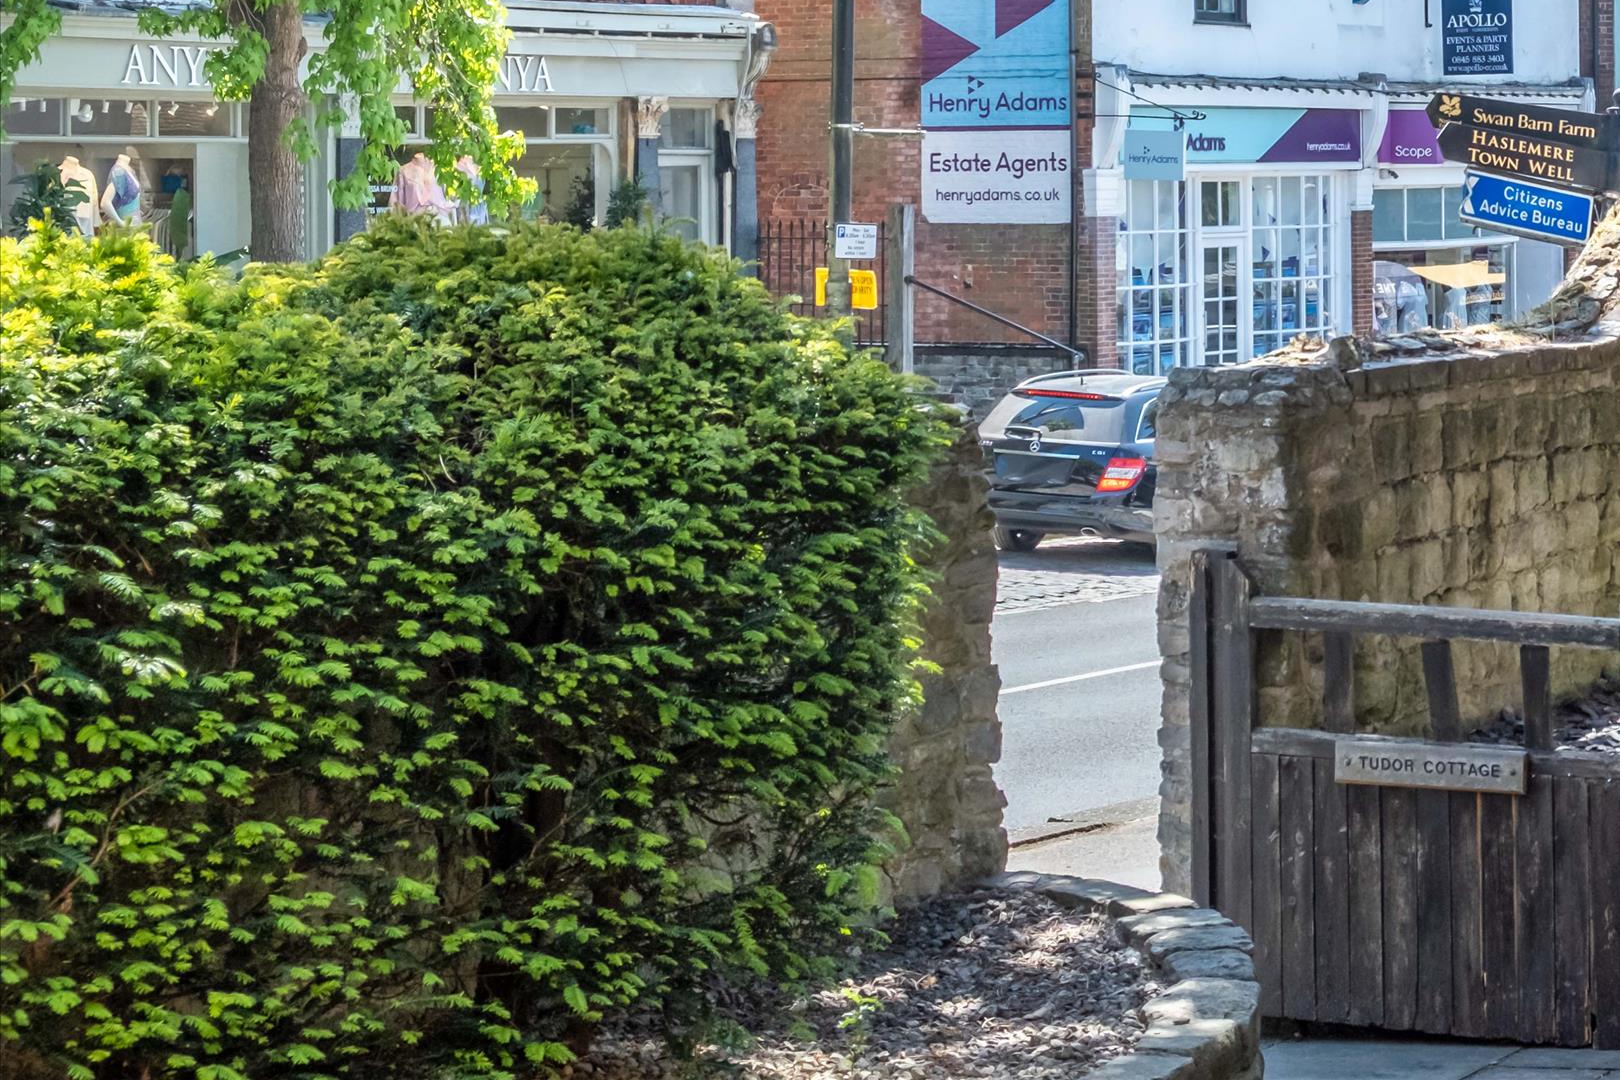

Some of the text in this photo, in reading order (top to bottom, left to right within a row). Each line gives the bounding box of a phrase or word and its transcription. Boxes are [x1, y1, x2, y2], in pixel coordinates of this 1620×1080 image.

[1446, 13, 1507, 28] APOLLO
[1446, 34, 1508, 45] EVENTS & PARTY
[1456, 44, 1500, 53] PLANNERS
[121, 44, 213, 86] ANY
[494, 55, 555, 92] NYA
[929, 92, 1067, 118] Henry Adams
[1473, 108, 1596, 138] Swan Barn Farm
[1186, 133, 1226, 151] Adams
[1395, 145, 1433, 159] Scope
[1472, 130, 1574, 162] HASLEMERE
[930, 152, 1067, 179] Estate Agents
[1128, 153, 1179, 164] Henry Adams
[1468, 147, 1575, 181] TOWN WELL
[936, 188, 1060, 205] henryadams.co.uk
[1503, 186, 1563, 211] Citizens
[1479, 199, 1583, 233] Advice Bureau
[1359, 756, 1501, 778] TUDOR COTTAGE
